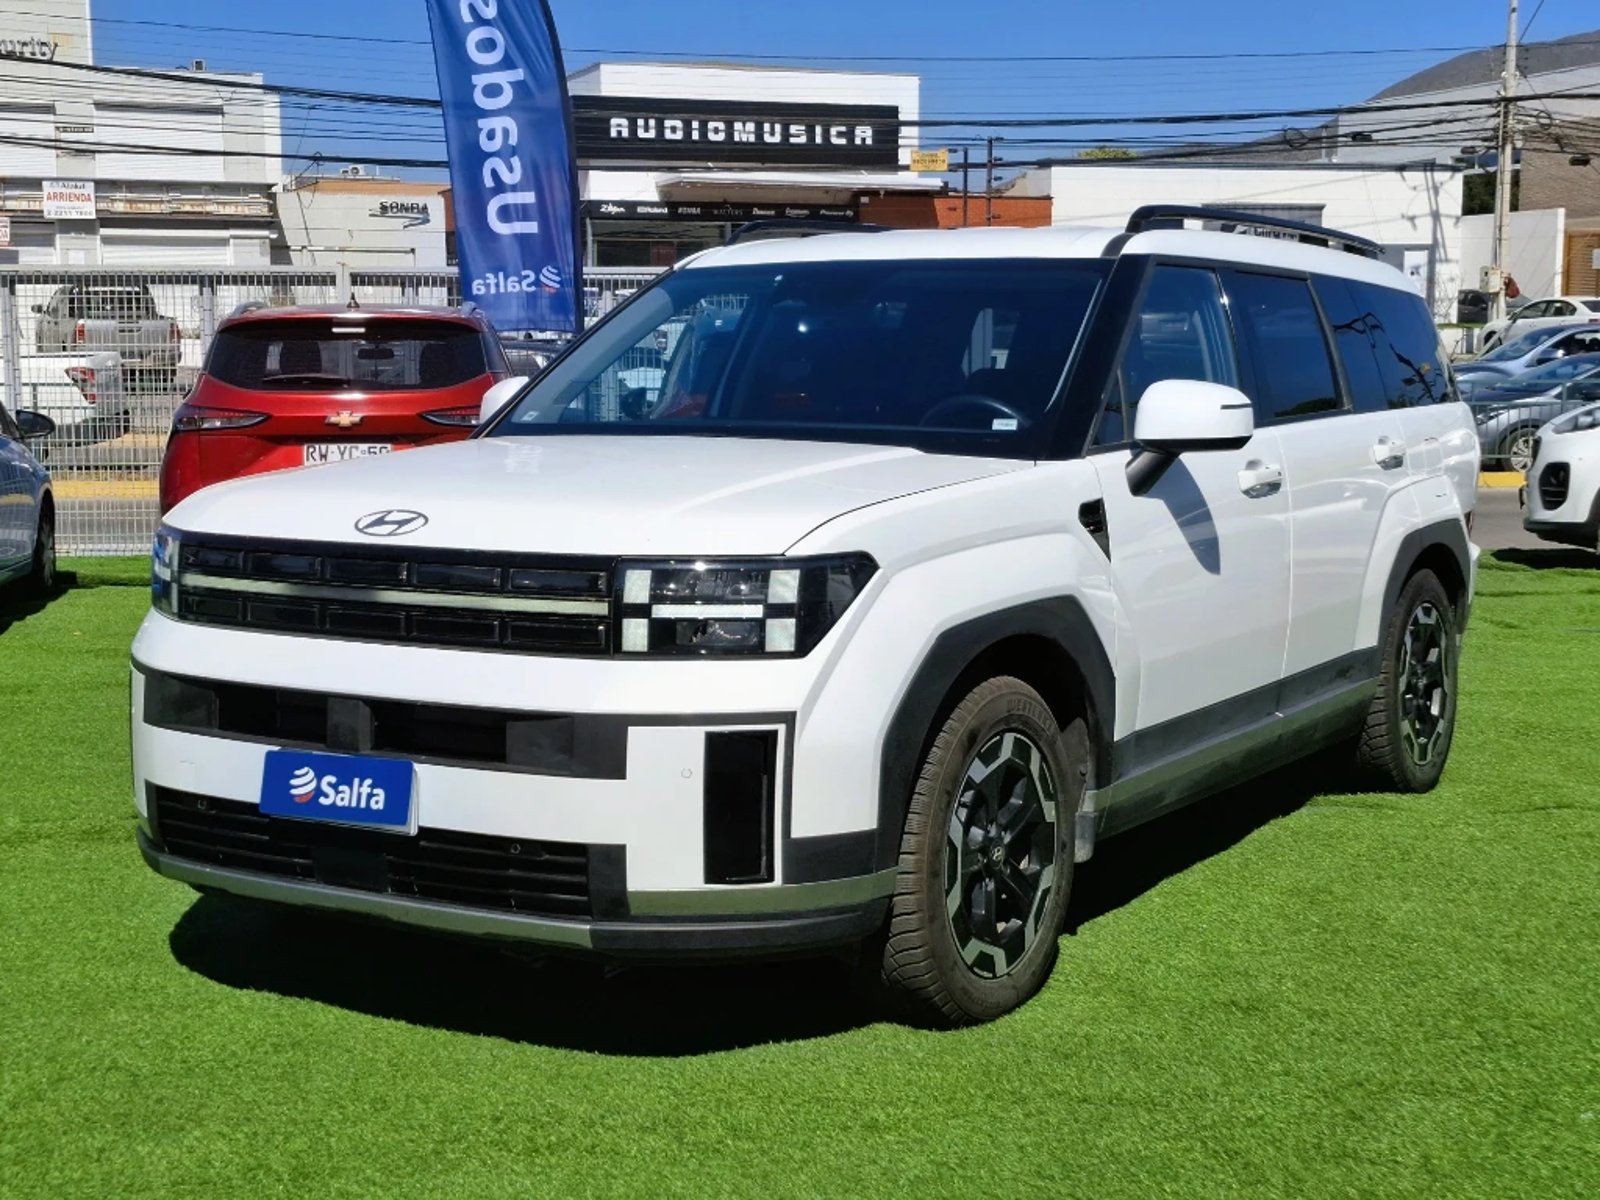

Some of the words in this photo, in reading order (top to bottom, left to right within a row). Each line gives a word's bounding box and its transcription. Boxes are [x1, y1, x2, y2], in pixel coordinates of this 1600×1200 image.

[610, 117, 872, 145] AUDIOMUSICA
[46, 192, 92, 202] ARRIENDA
[319, 775, 385, 810] Salfa
